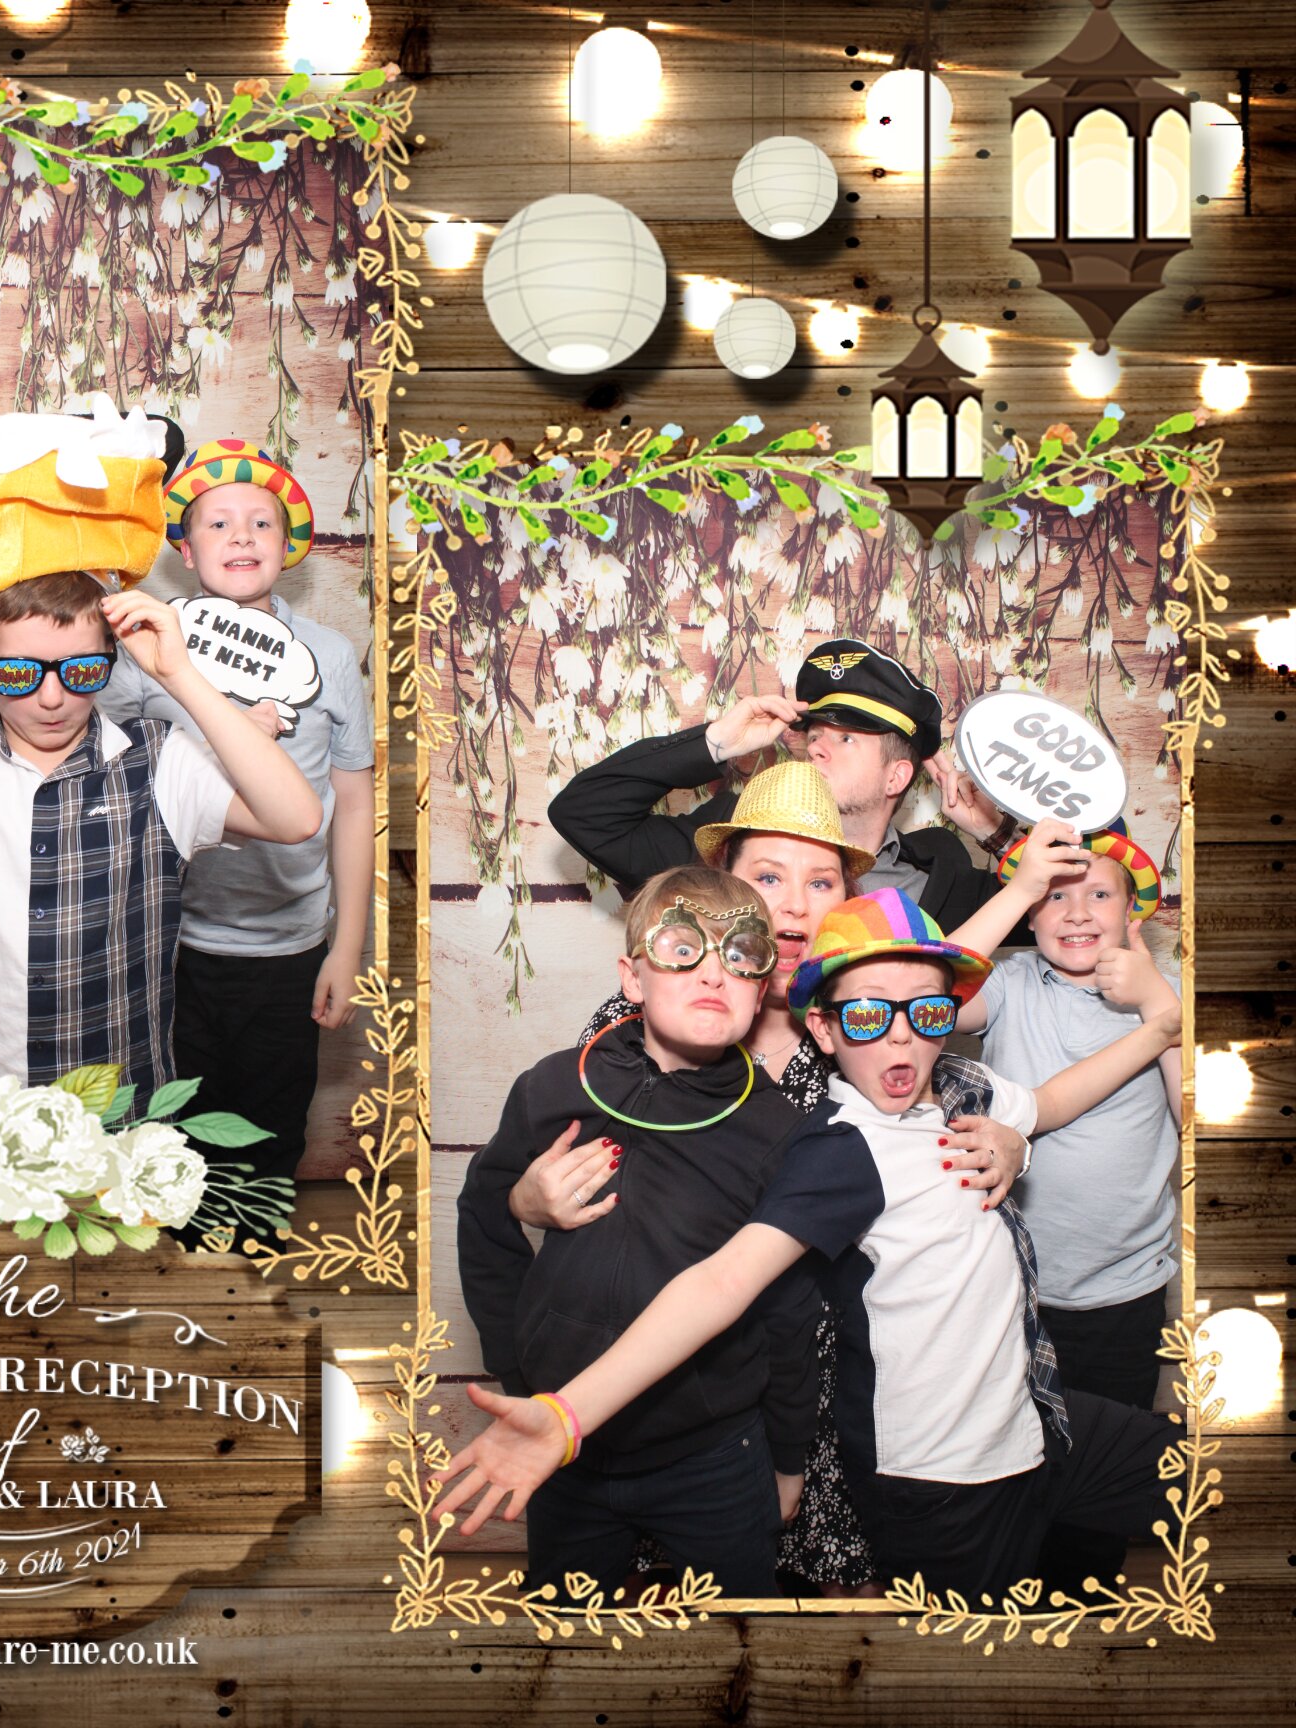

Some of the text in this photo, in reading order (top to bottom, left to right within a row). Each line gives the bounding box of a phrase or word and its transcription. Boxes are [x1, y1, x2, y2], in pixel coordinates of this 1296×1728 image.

[186, 633, 277, 682] BE NEXT
[194, 609, 286, 659] I WANNA
[64, 662, 109, 687] POW!
[1013, 712, 1106, 772] GOOD
[983, 740, 1092, 819] TIMES
[846, 1005, 956, 1028] BAM! POW!
